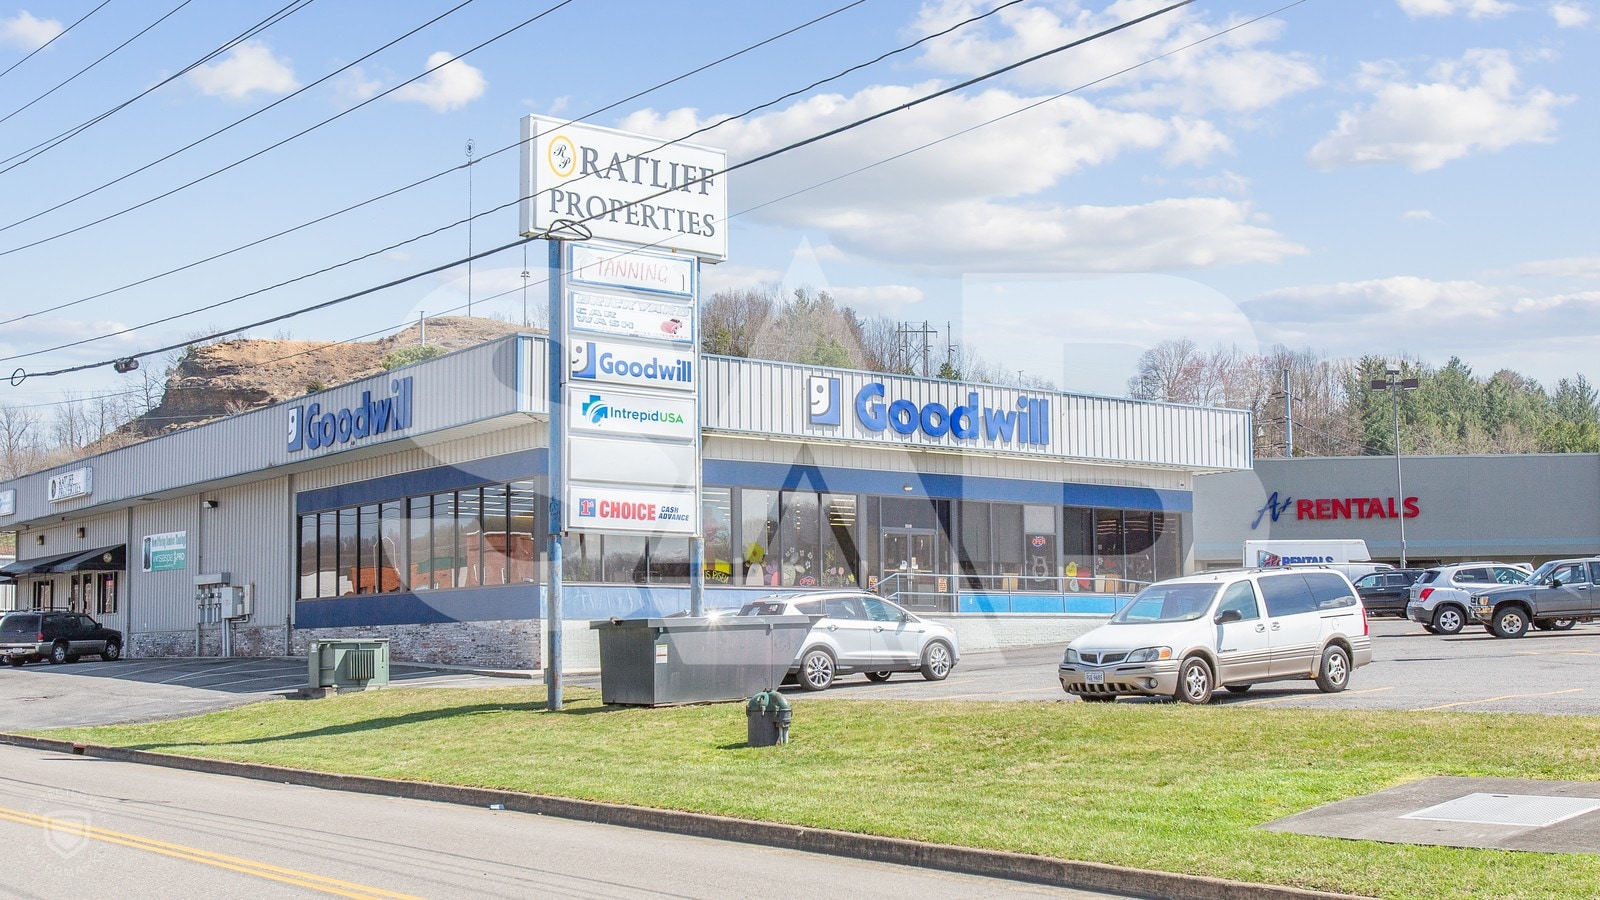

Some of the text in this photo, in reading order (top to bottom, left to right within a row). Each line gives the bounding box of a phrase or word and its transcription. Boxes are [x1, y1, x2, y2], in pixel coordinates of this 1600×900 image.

[579, 146, 715, 195] RATLIFF
[549, 189, 715, 237] PROPERTIES
[596, 256, 669, 284] TANNING
[575, 307, 617, 319] CAR
[576, 294, 690, 318] BRICKYARD
[576, 315, 634, 330] WASH
[600, 352, 692, 383] Goodwill
[304, 376, 413, 450] Goodwill
[856, 382, 1050, 446] Goodwill
[599, 501, 656, 521] CHOICE
[658, 513, 690, 521] ADVANCE
[660, 506, 679, 514] CASH
[1296, 497, 1421, 521] RENTALS
[800, 576, 816, 587] OPEN
